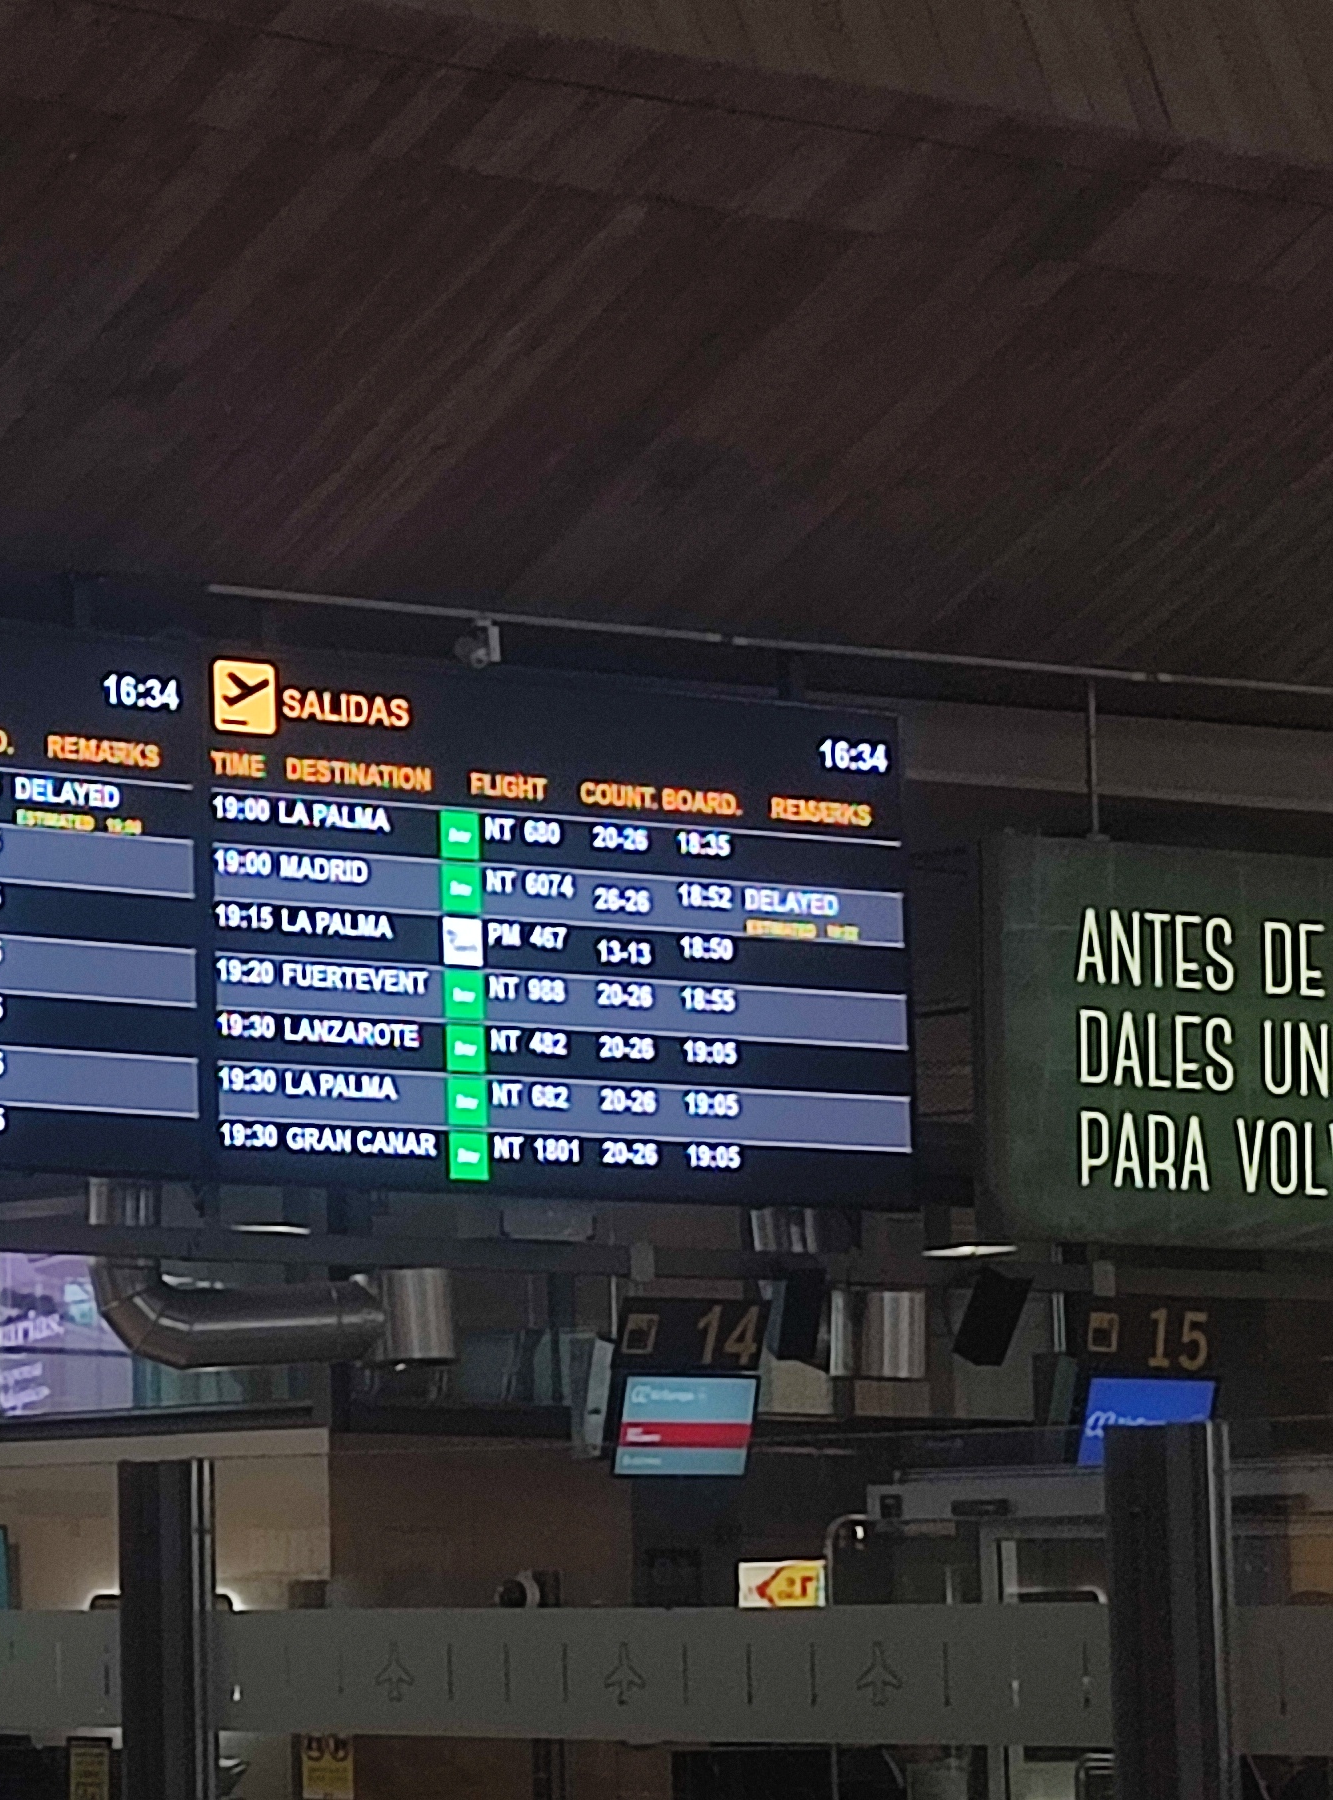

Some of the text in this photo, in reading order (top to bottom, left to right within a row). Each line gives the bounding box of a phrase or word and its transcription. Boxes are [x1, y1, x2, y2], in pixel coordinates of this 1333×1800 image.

[103, 674, 180, 710] 16:34
[282, 688, 410, 727] SALIDAS
[47, 735, 160, 767] REMARKS
[819, 739, 888, 773] 16:34
[14, 776, 120, 809] DELAYED
[211, 751, 264, 777] TIME
[286, 757, 431, 791] DESTINATION
[470, 772, 546, 799] FLIGHT
[662, 788, 742, 816] BOARD.
[213, 848, 272, 876] 19:00
[279, 854, 369, 884] MADRID
[485, 868, 517, 894] NT
[744, 887, 840, 916] DELAYED
[1076, 907, 1326, 998] ANTES DE
[1079, 1008, 1331, 1098] DALES UN
[1080, 1110, 1333, 1197] PARA VOL
[697, 1304, 760, 1366] 14
[1148, 1308, 1209, 1371] 15
